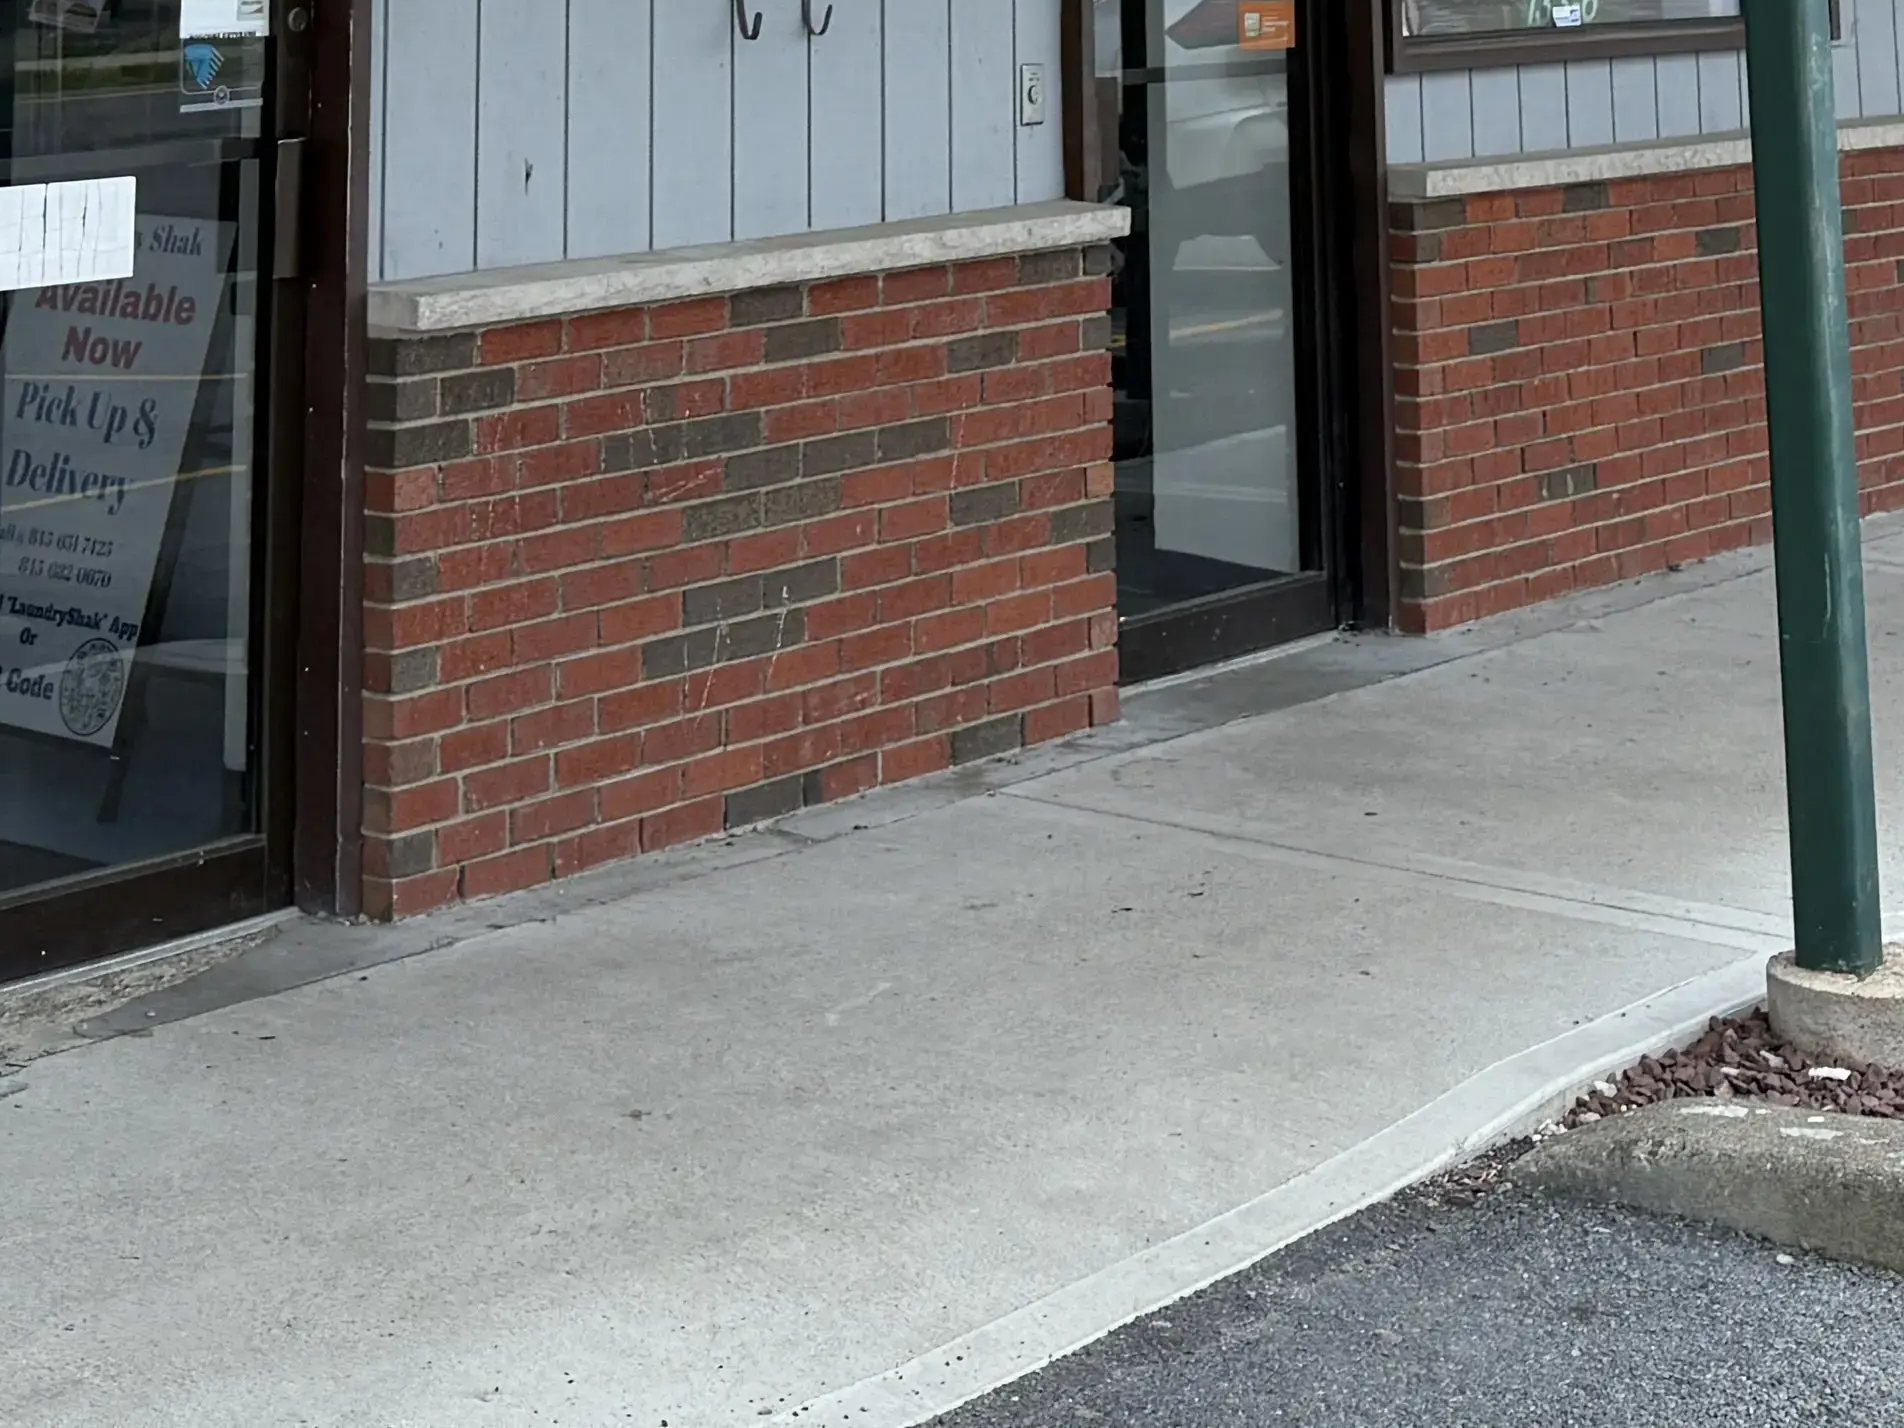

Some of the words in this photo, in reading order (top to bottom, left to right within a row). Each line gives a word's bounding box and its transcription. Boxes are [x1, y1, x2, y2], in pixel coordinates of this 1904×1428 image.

[149, 224, 203, 257] Shak
[35, 279, 196, 326] Available
[61, 325, 142, 370] Now
[15, 379, 79, 429] Pick
[86, 389, 129, 444] Up
[132, 397, 159, 450] &
[5, 447, 133, 516] Delivery
[19, 626, 39, 645] Or
[6, 667, 55, 701] Code
